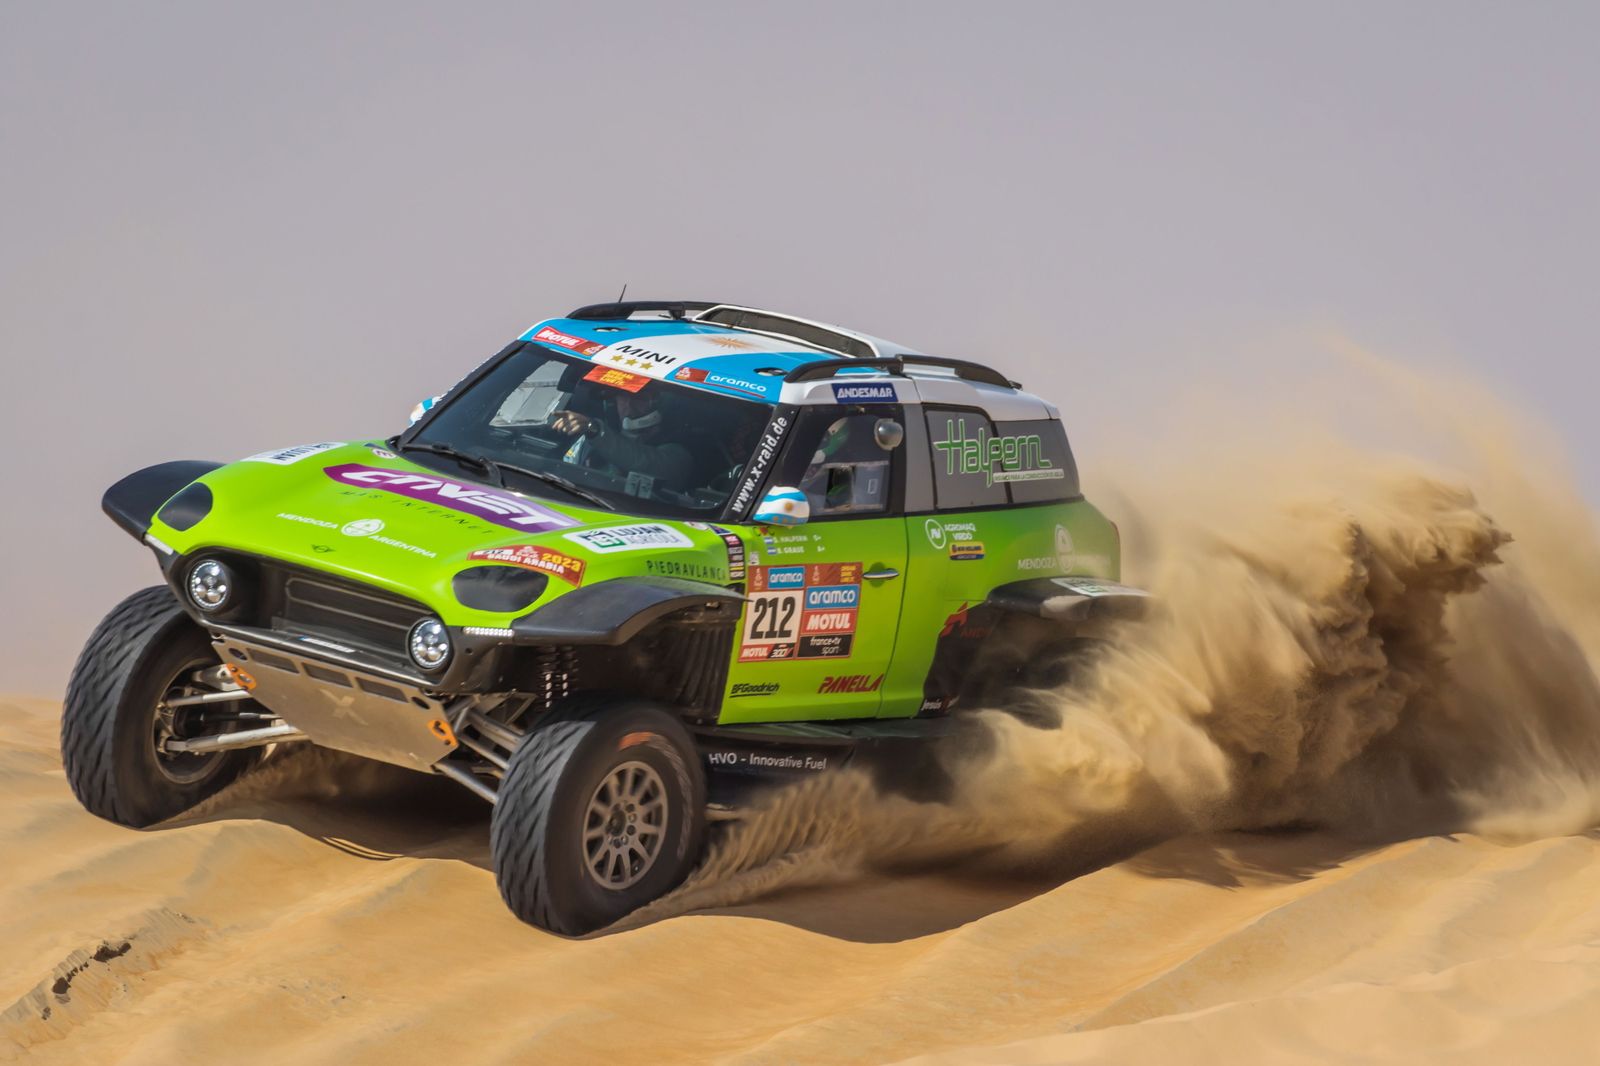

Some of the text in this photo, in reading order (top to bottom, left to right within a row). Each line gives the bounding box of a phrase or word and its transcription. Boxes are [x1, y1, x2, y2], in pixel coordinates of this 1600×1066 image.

[539, 330, 581, 347] MOTUL
[616, 345, 677, 365] MINI
[709, 374, 768, 392] aramco
[837, 387, 894, 399] ANDESMAR
[933, 418, 1053, 488] Halpern
[731, 416, 788, 513] www.x-raid.de
[391, 499, 496, 535] INTERNET
[277, 512, 437, 559] MENDOZA ARGENTINA
[487, 552, 521, 563] SAUDI
[523, 556, 565, 574] ARABIA
[541, 552, 582, 573] 2023
[769, 572, 803, 584] aramco
[809, 589, 856, 605] aramco
[750, 596, 797, 640] 212
[806, 612, 851, 631] MOTUL
[741, 646, 769, 658] MOTUL
[731, 682, 780, 694] BFGoodrich
[817, 673, 885, 694] PANELLA
[708, 752, 737, 765] HVO
[749, 752, 803, 769] Innovative
[804, 757, 828, 770] Fuel
